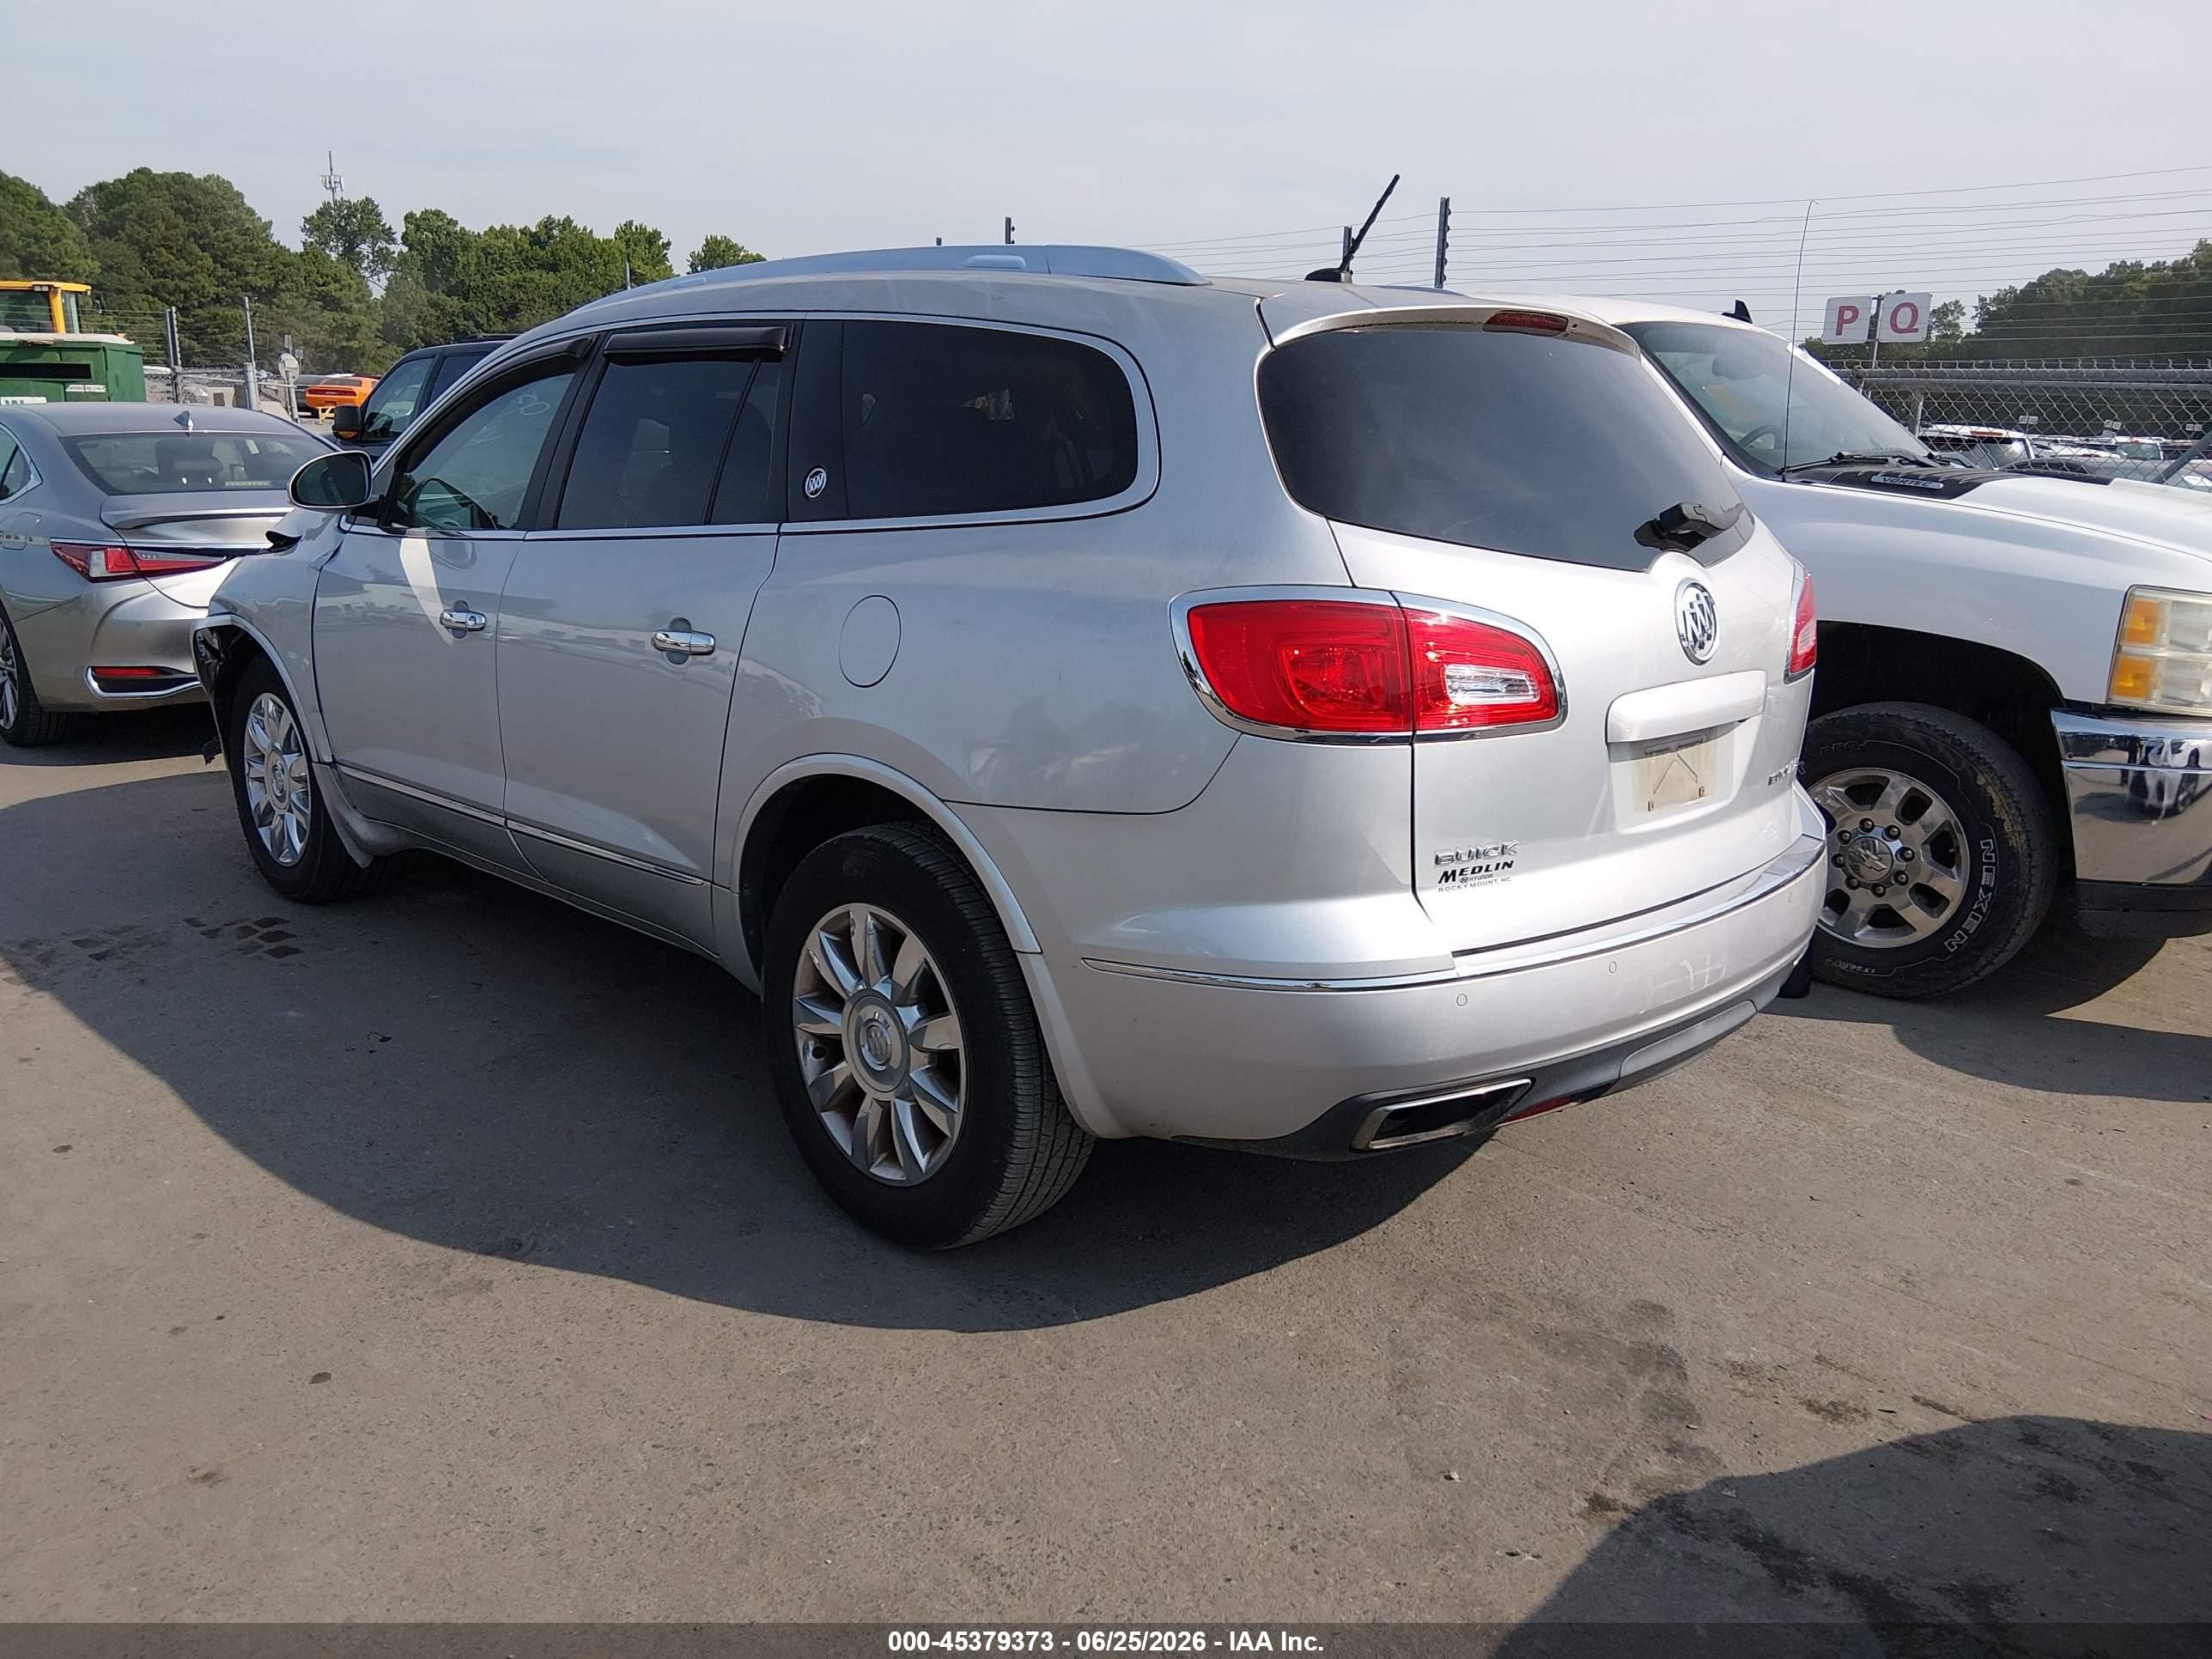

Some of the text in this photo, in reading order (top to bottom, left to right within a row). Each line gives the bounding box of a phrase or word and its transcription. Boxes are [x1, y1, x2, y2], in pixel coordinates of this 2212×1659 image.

[1836, 305, 1859, 336] P
[1890, 302, 1918, 334] Q
[1882, 477, 1932, 487] VORTEC
[1434, 841, 1521, 866] BUICK
[1437, 860, 1515, 884] MEDLIN
[1438, 884, 1468, 892] ROCKY
[1943, 838, 1998, 953] NEXEN
